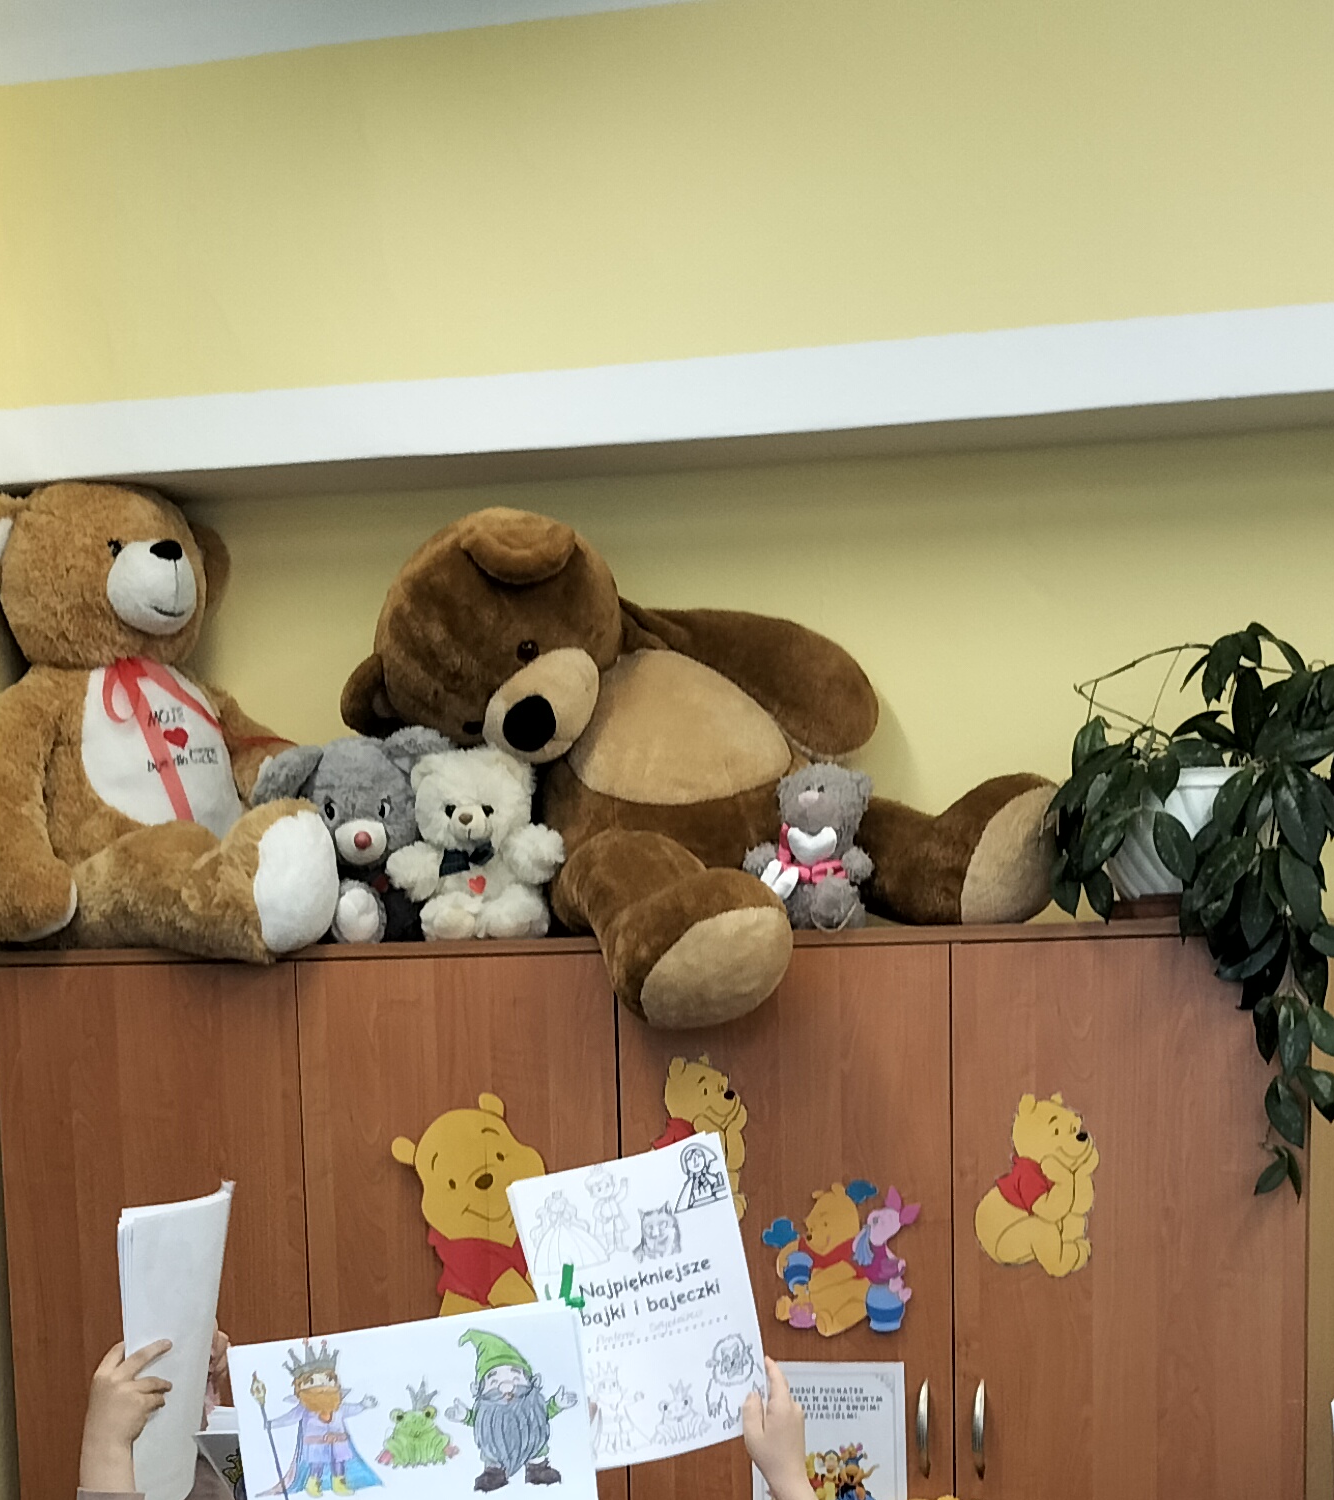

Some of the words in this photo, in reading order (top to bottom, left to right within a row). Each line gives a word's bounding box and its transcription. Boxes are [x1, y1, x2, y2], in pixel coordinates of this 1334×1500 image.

[579, 1258, 711, 1299] Najpiękniejsze
[580, 1302, 625, 1327] bajki
[646, 1278, 721, 1311] bajeczki
